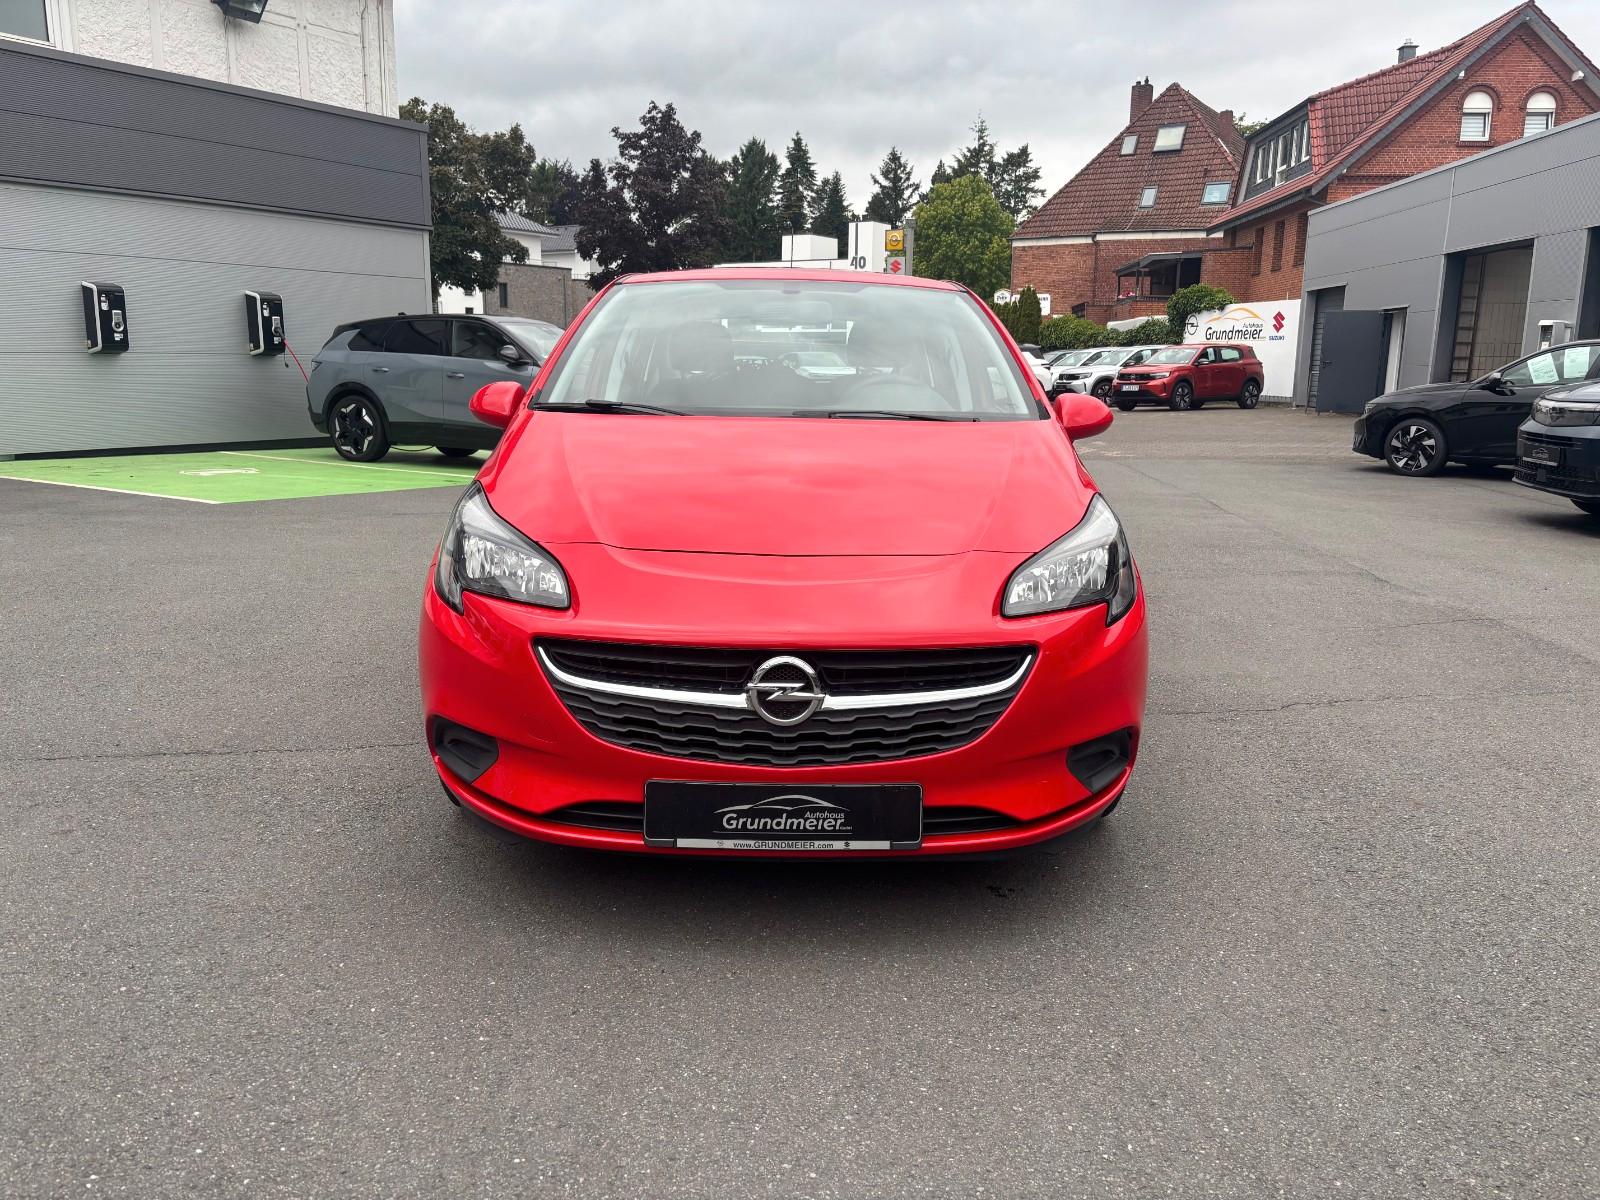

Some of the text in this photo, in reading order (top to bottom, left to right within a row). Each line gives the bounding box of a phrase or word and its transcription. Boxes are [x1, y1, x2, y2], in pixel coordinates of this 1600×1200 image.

[850, 256, 866, 270] 40
[1205, 325, 1262, 340] Grundmeier
[722, 813, 845, 830] Grundmeier
[804, 811, 845, 819] Autohaus
[733, 841, 834, 849] www.GRUNDMEIER.com
